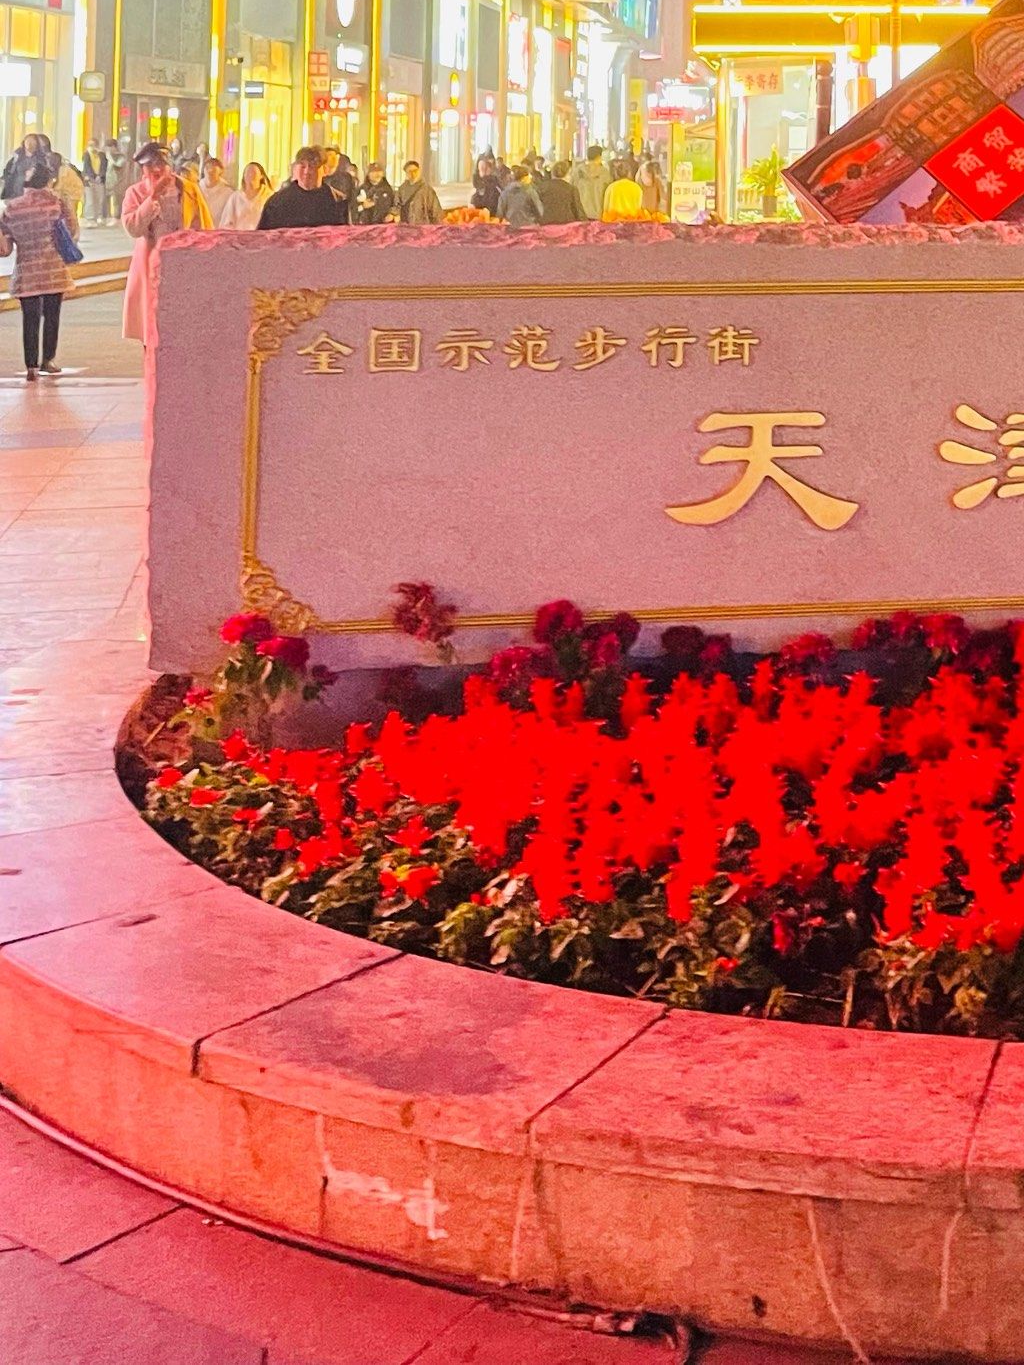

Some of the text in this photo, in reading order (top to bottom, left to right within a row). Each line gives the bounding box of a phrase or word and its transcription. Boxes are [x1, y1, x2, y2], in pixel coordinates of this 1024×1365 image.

[297, 324, 760, 375] 全国示范步行街
